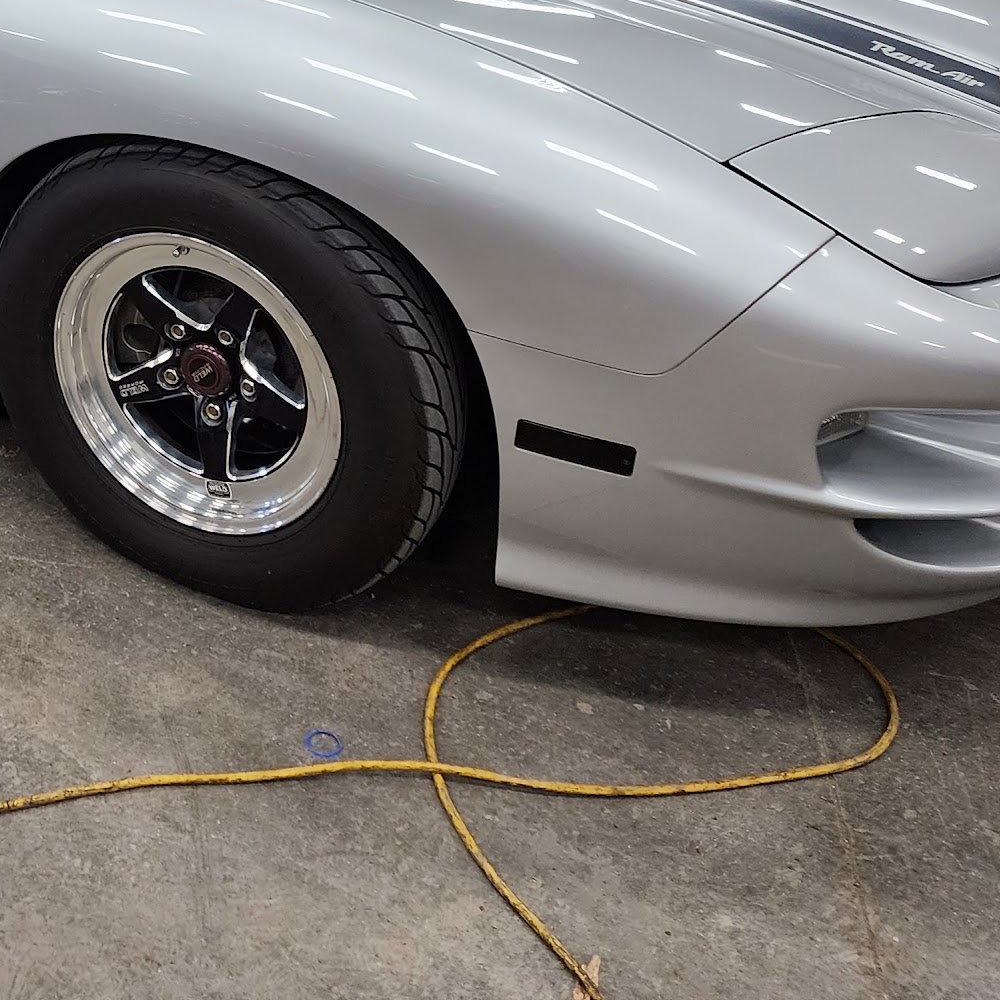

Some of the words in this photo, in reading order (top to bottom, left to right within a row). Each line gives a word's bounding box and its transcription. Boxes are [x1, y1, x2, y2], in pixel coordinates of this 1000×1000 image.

[869, 40, 940, 74] Ram
[941, 70, 986, 87] Air
[120, 383, 150, 398] WELD
